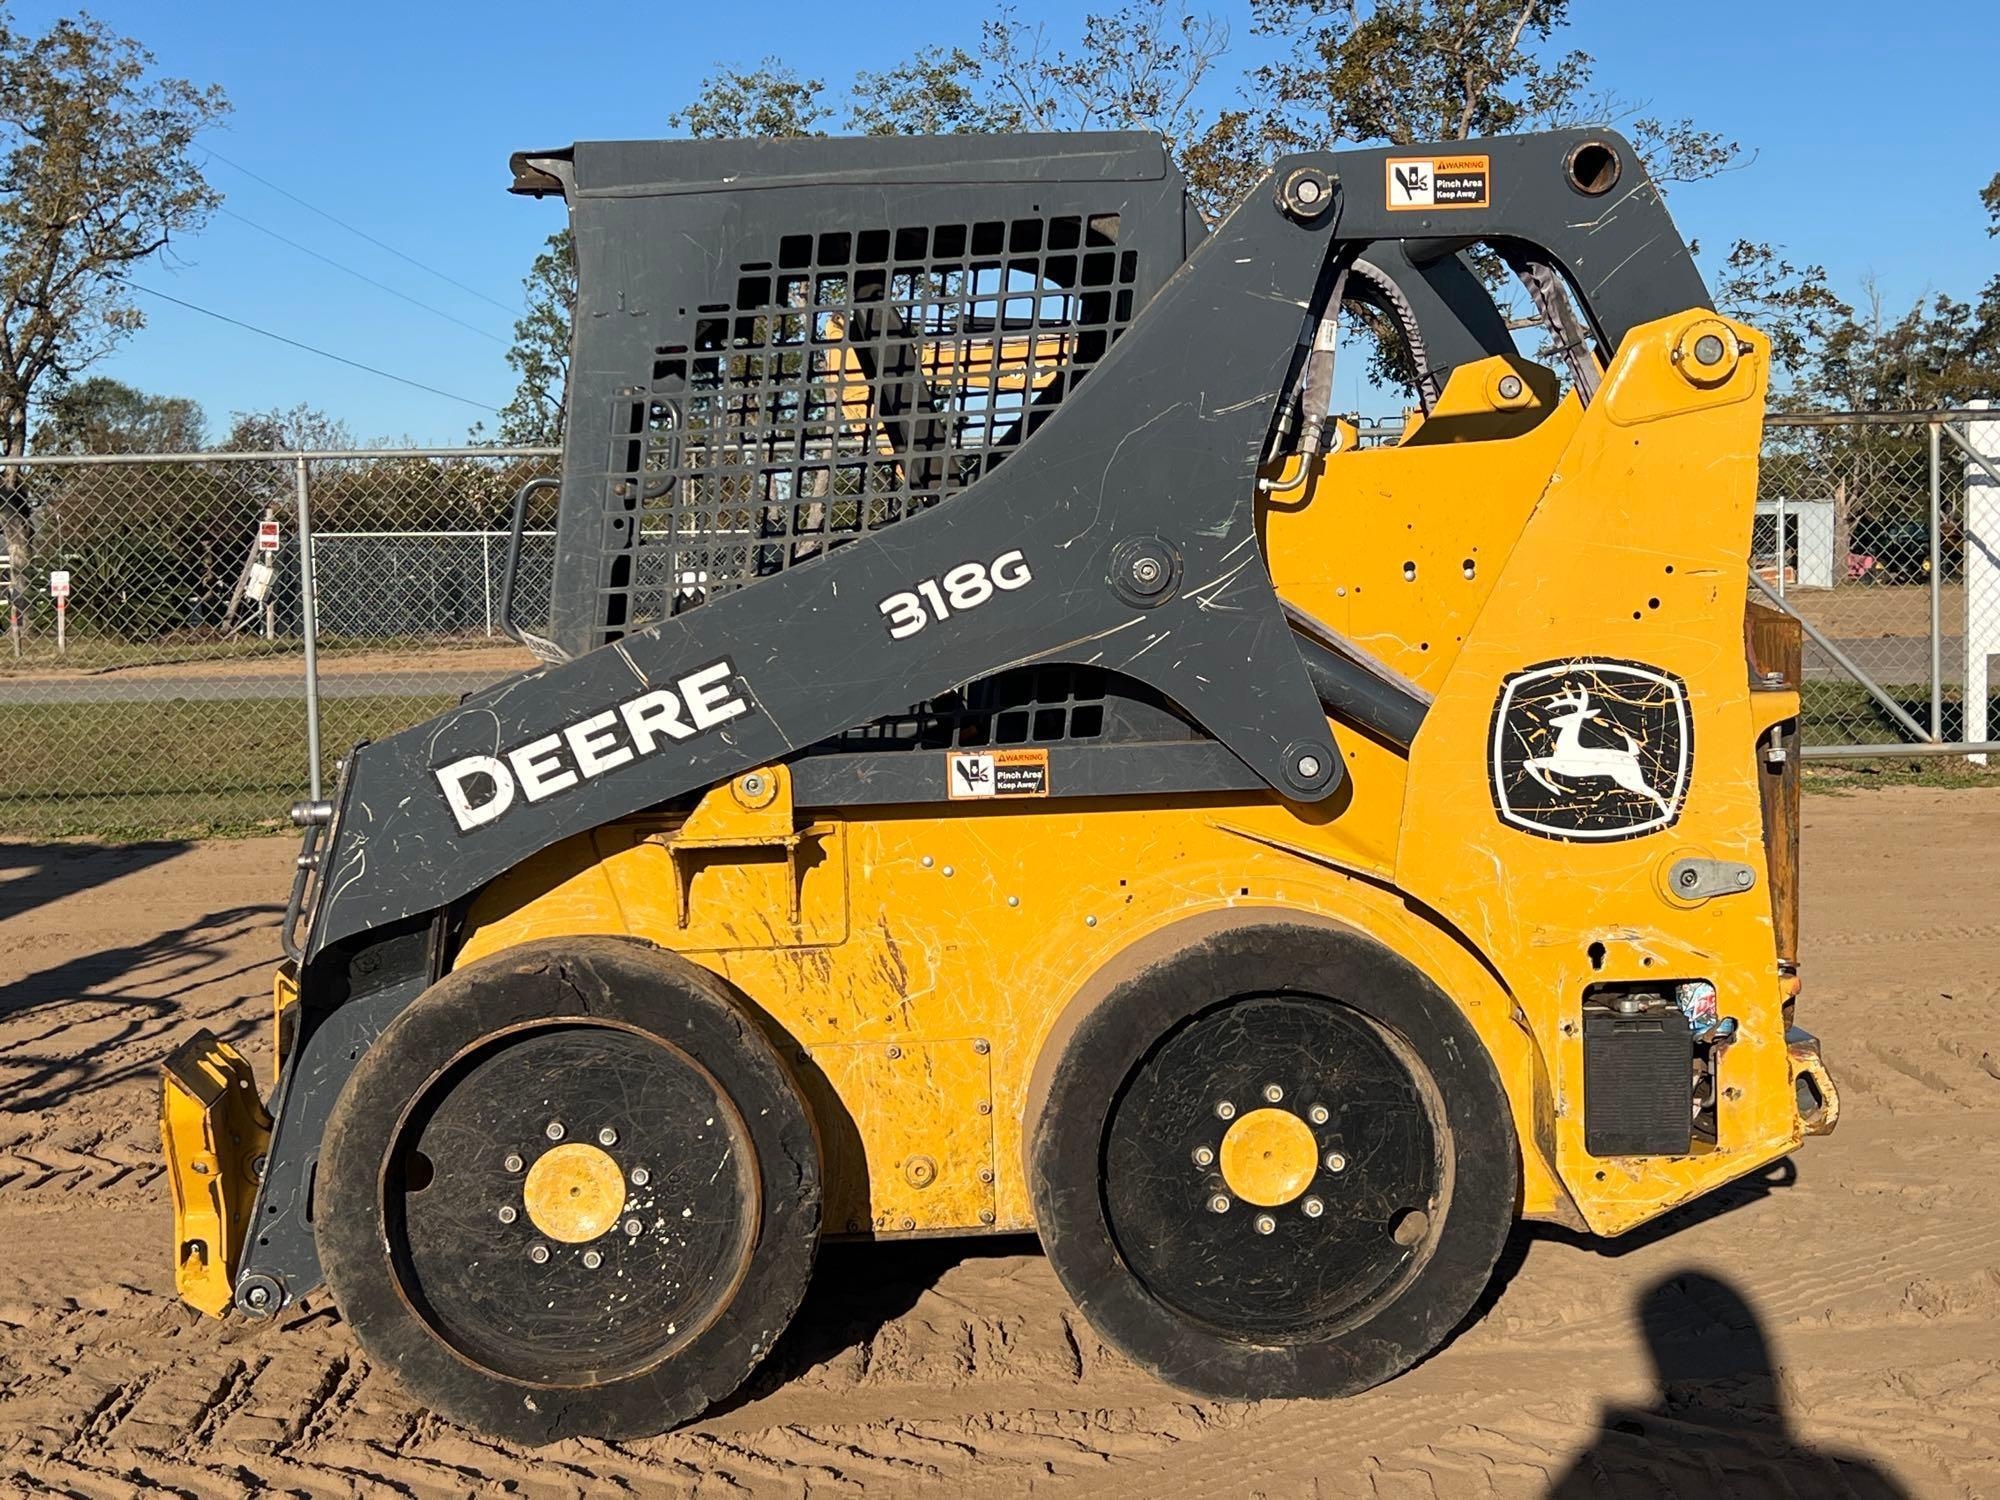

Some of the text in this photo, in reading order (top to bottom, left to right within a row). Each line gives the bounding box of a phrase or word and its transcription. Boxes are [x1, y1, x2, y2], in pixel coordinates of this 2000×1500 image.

[1445, 161, 1484, 169] WARNING
[1436, 179, 1483, 188] Pinch Area
[1436, 190, 1477, 199] Keep Away
[879, 550, 1032, 640] 318G
[435, 662, 747, 832] DEERE
[1005, 754, 1043, 762] WARNING
[997, 770, 1043, 780] Pinch Area
[997, 781, 1038, 790] Keep Away
